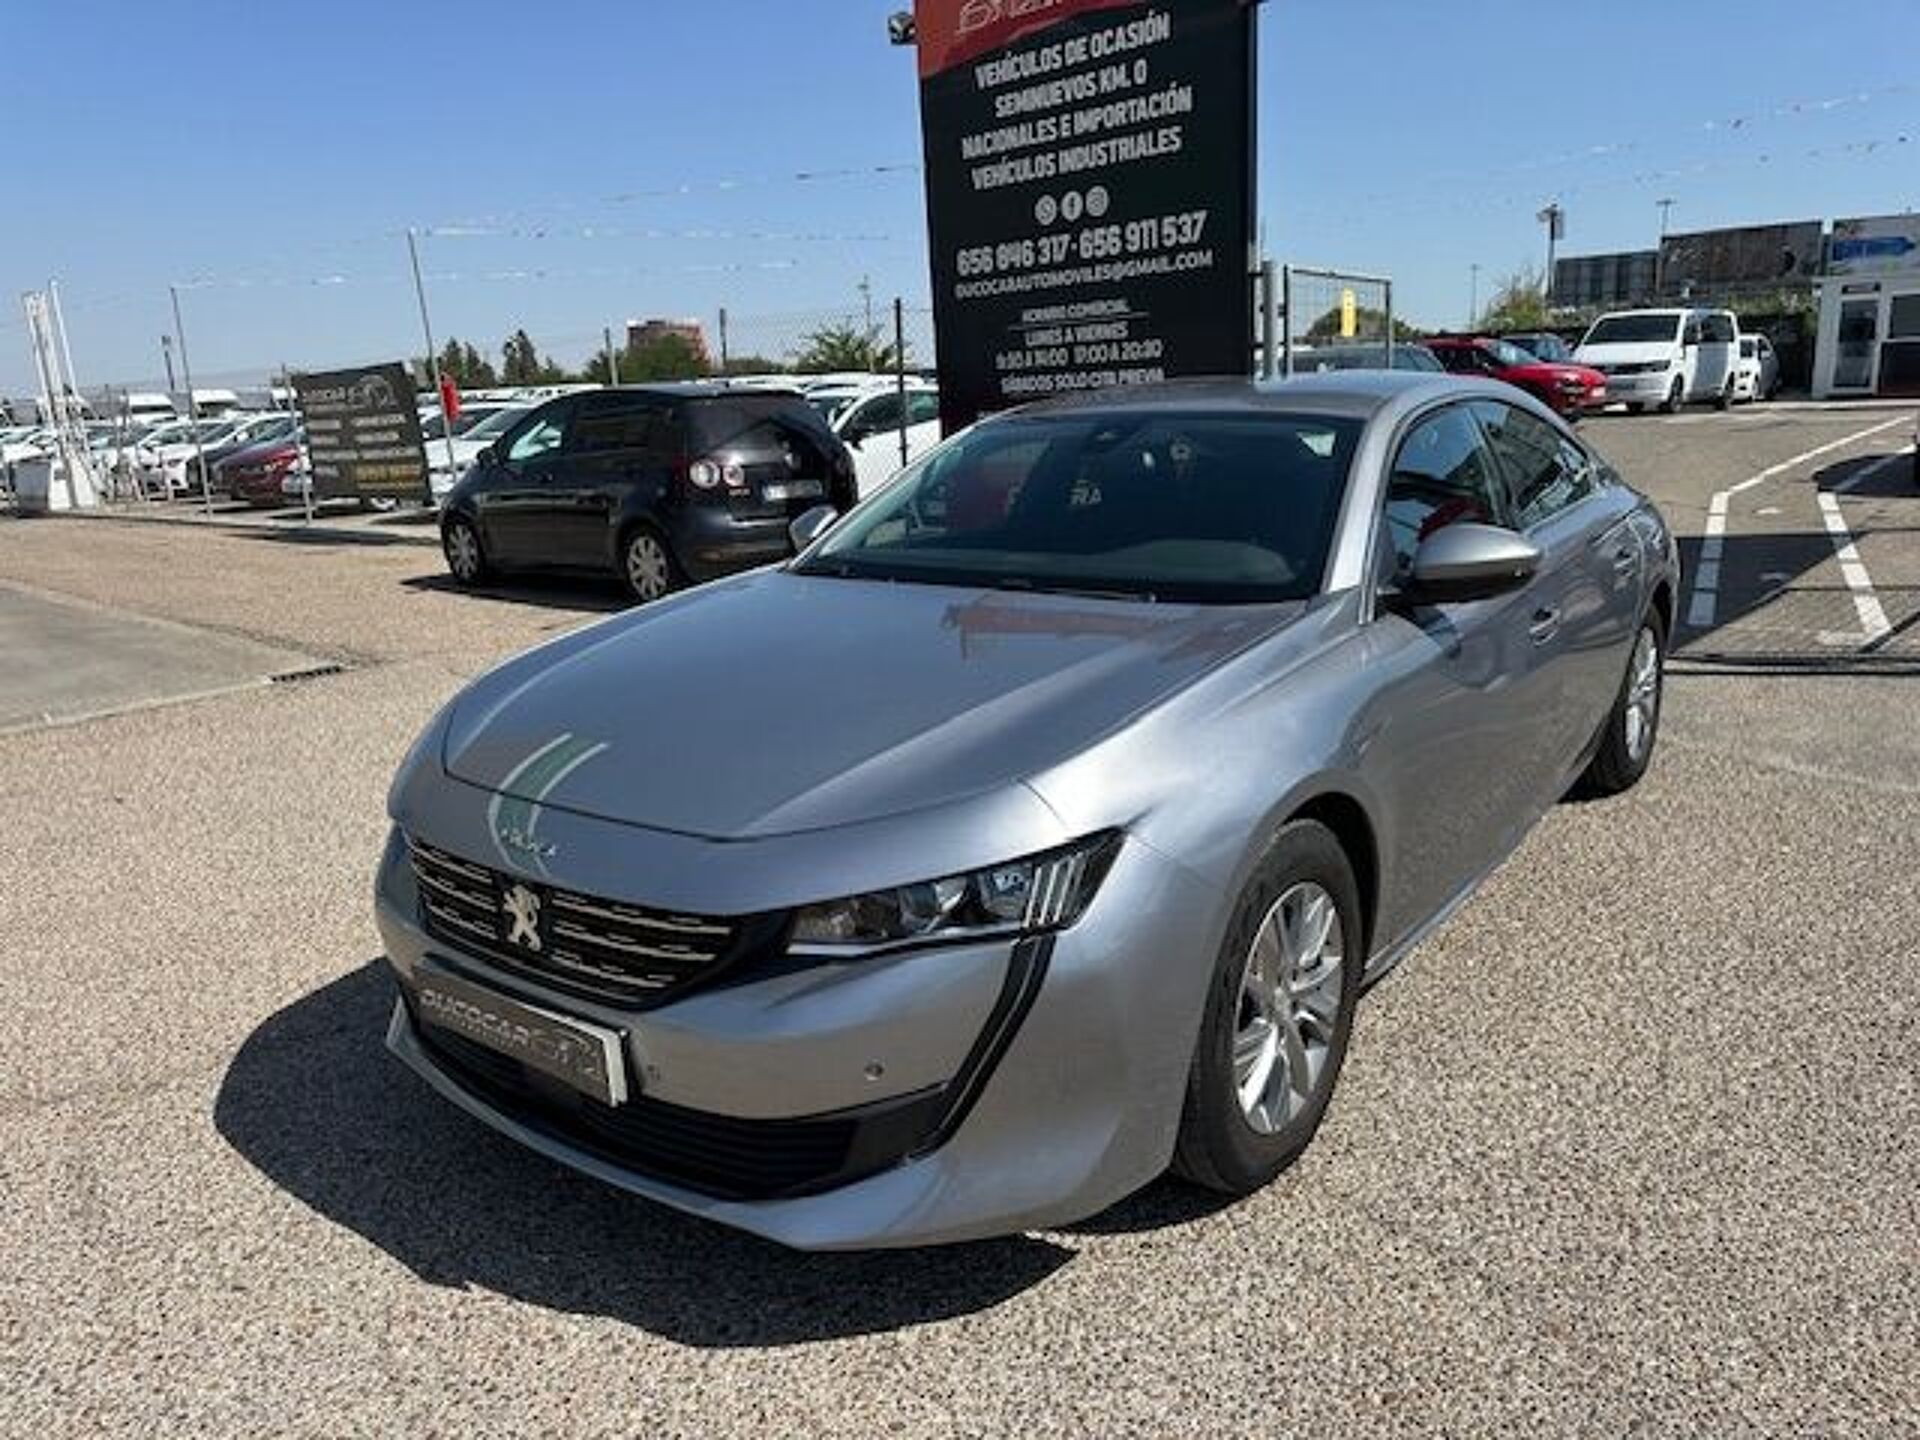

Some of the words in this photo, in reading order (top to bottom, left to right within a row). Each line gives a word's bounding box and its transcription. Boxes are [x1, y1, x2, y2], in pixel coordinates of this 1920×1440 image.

[975, 51, 1062, 89] VEHÍCULOS
[1065, 37, 1088, 66] DE
[1090, 9, 1171, 58] OCASIÓN
[962, 117, 1058, 160] NACIONALES
[1060, 113, 1071, 138] E
[1073, 81, 1192, 135] IMPORTACIÓN
[995, 71, 1097, 117] SEMINUEVOS
[971, 152, 1057, 190] VEHÍCULOS
[1058, 125, 1182, 173] INDUSTRIALES
[956, 245, 994, 276] 656
[1080, 224, 1122, 258] 656
[1124, 218, 1159, 252] 911
[1161, 209, 1207, 247] 537
[1064, 327, 1074, 343] A
